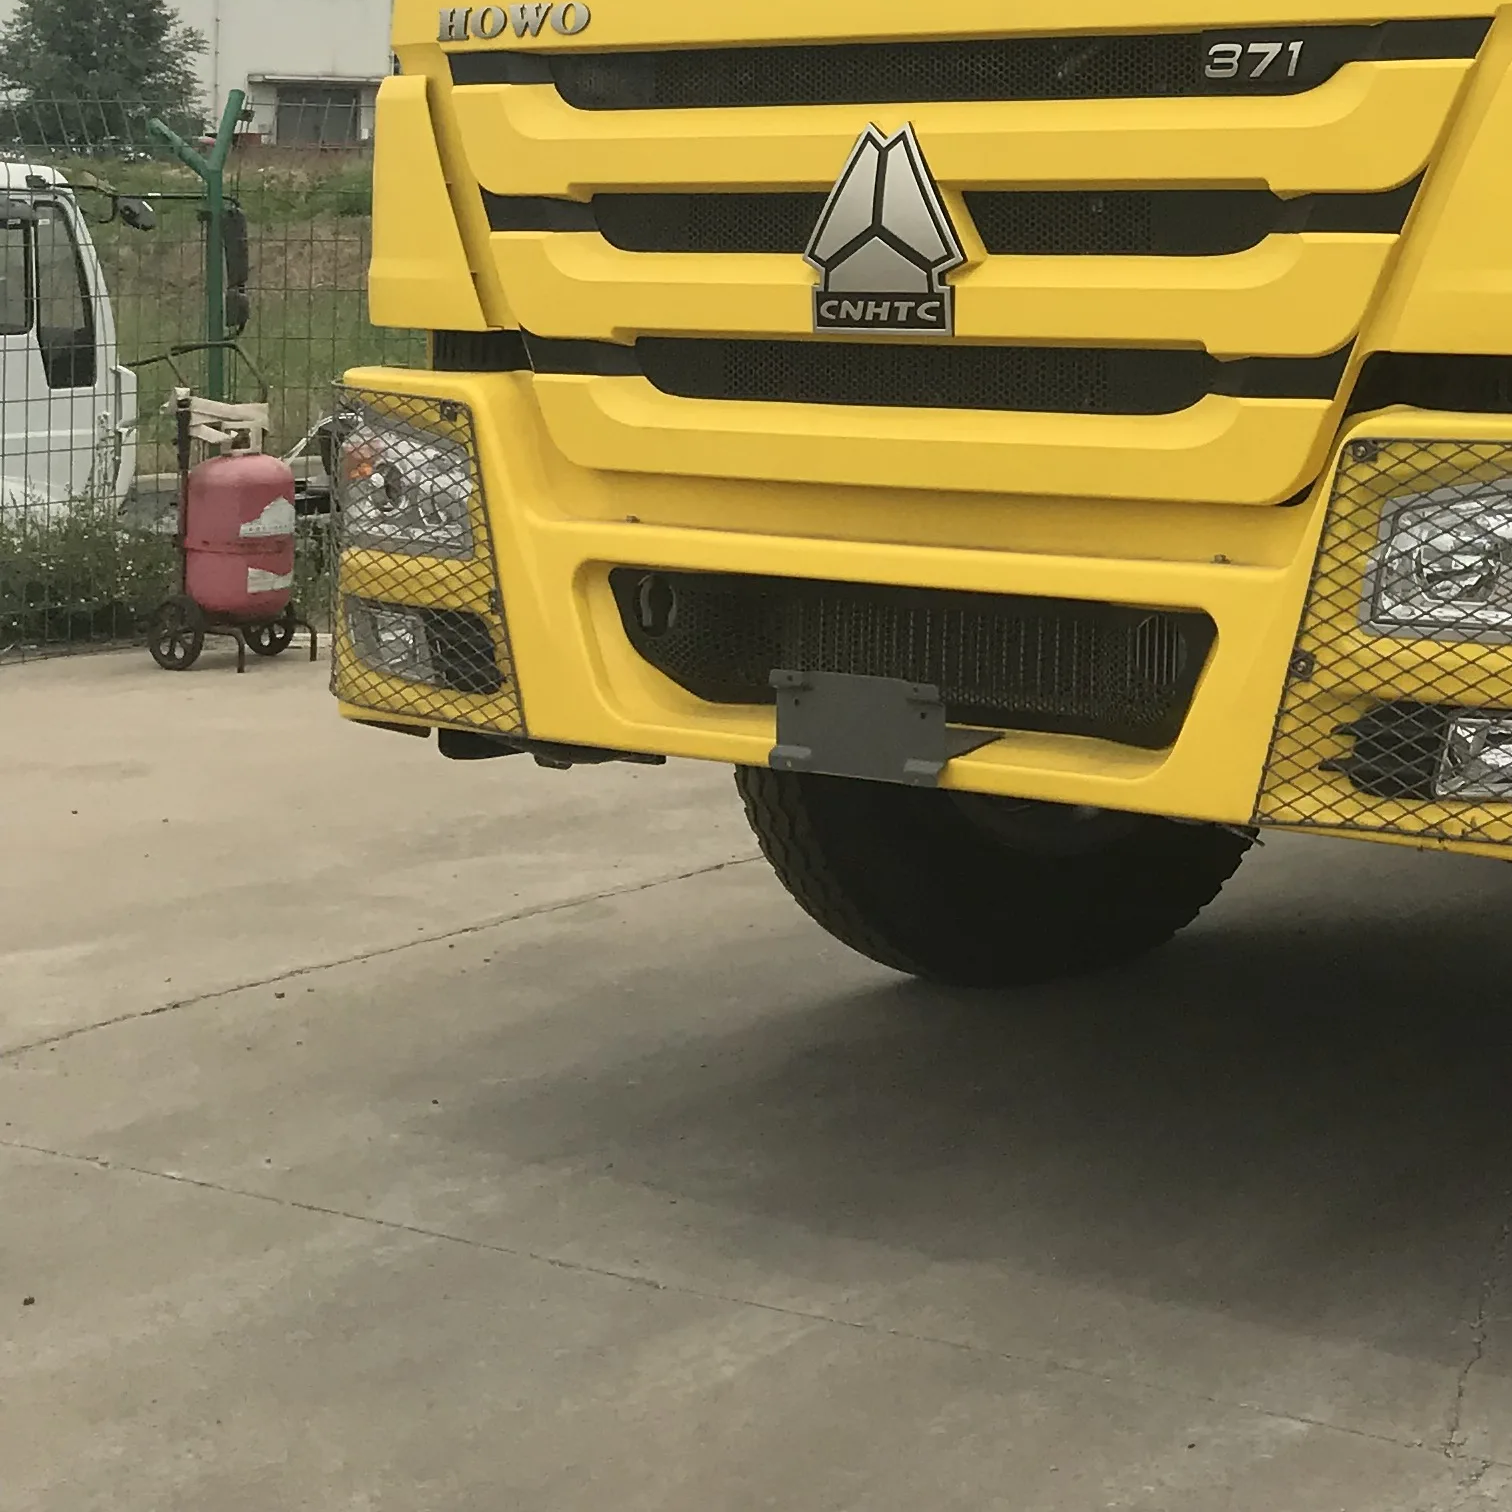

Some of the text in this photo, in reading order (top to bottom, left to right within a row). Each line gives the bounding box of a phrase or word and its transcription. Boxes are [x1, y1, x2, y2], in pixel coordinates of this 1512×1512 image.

[437, 1, 591, 41] HOWO
[1205, 40, 1304, 78] 371
[820, 300, 940, 322] CNHTC
